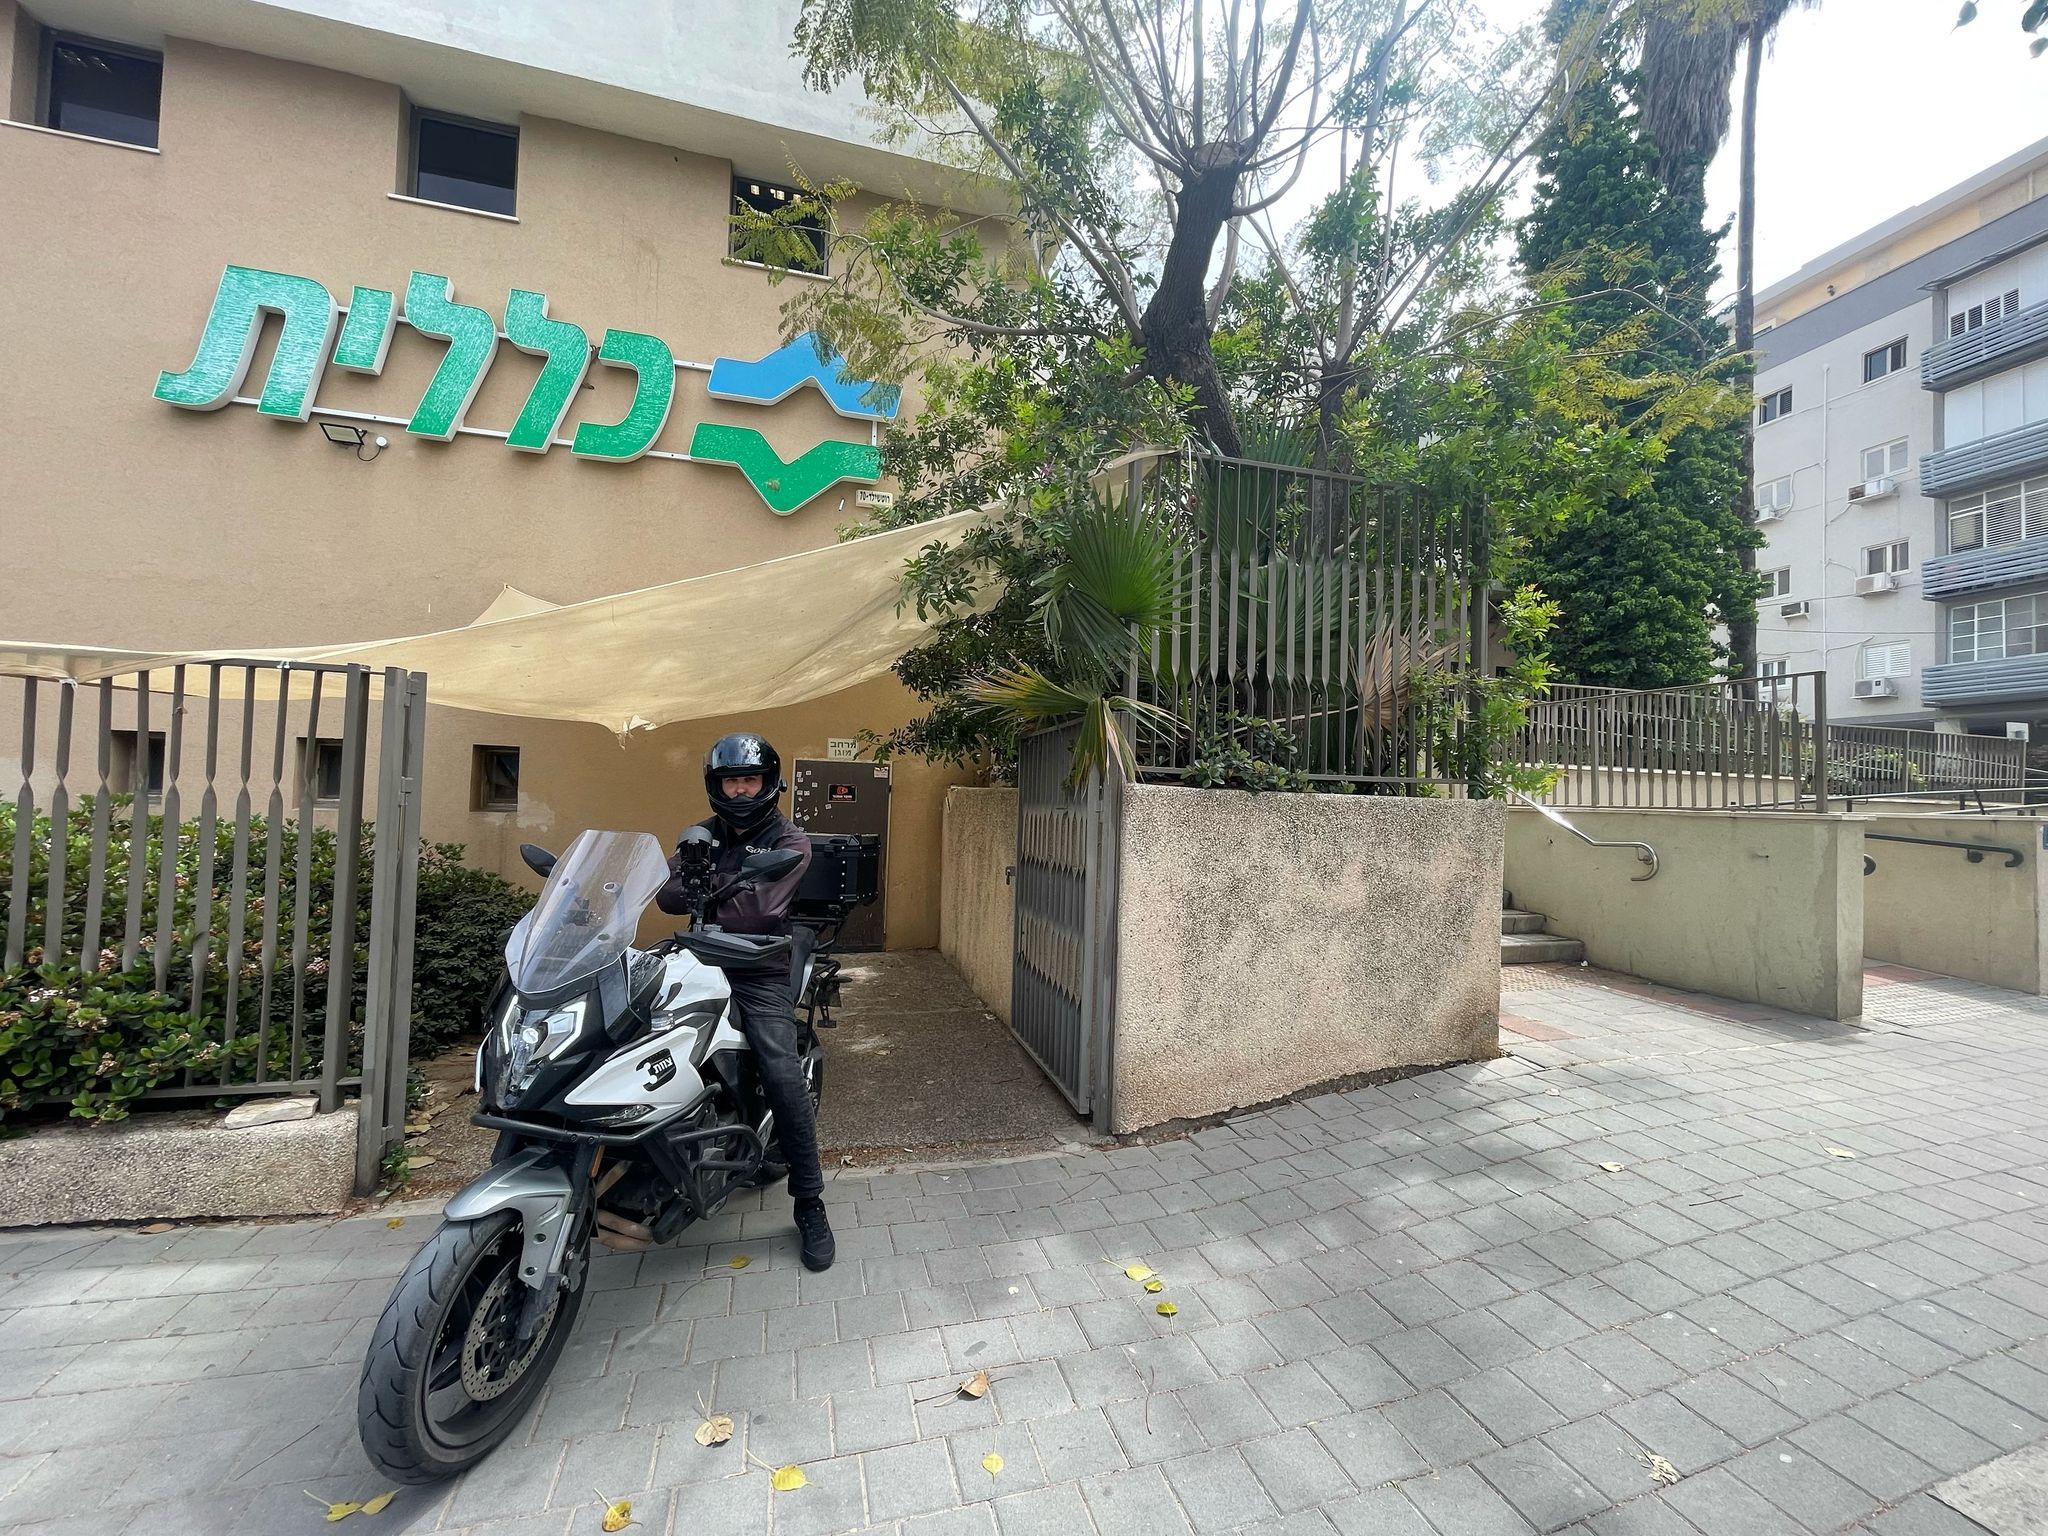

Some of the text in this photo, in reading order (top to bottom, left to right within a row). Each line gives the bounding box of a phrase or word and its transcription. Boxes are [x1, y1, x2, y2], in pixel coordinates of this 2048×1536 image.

[153, 264, 676, 463] כללית
[830, 740, 857, 749] מרחב
[834, 749, 852, 757] מוגן
